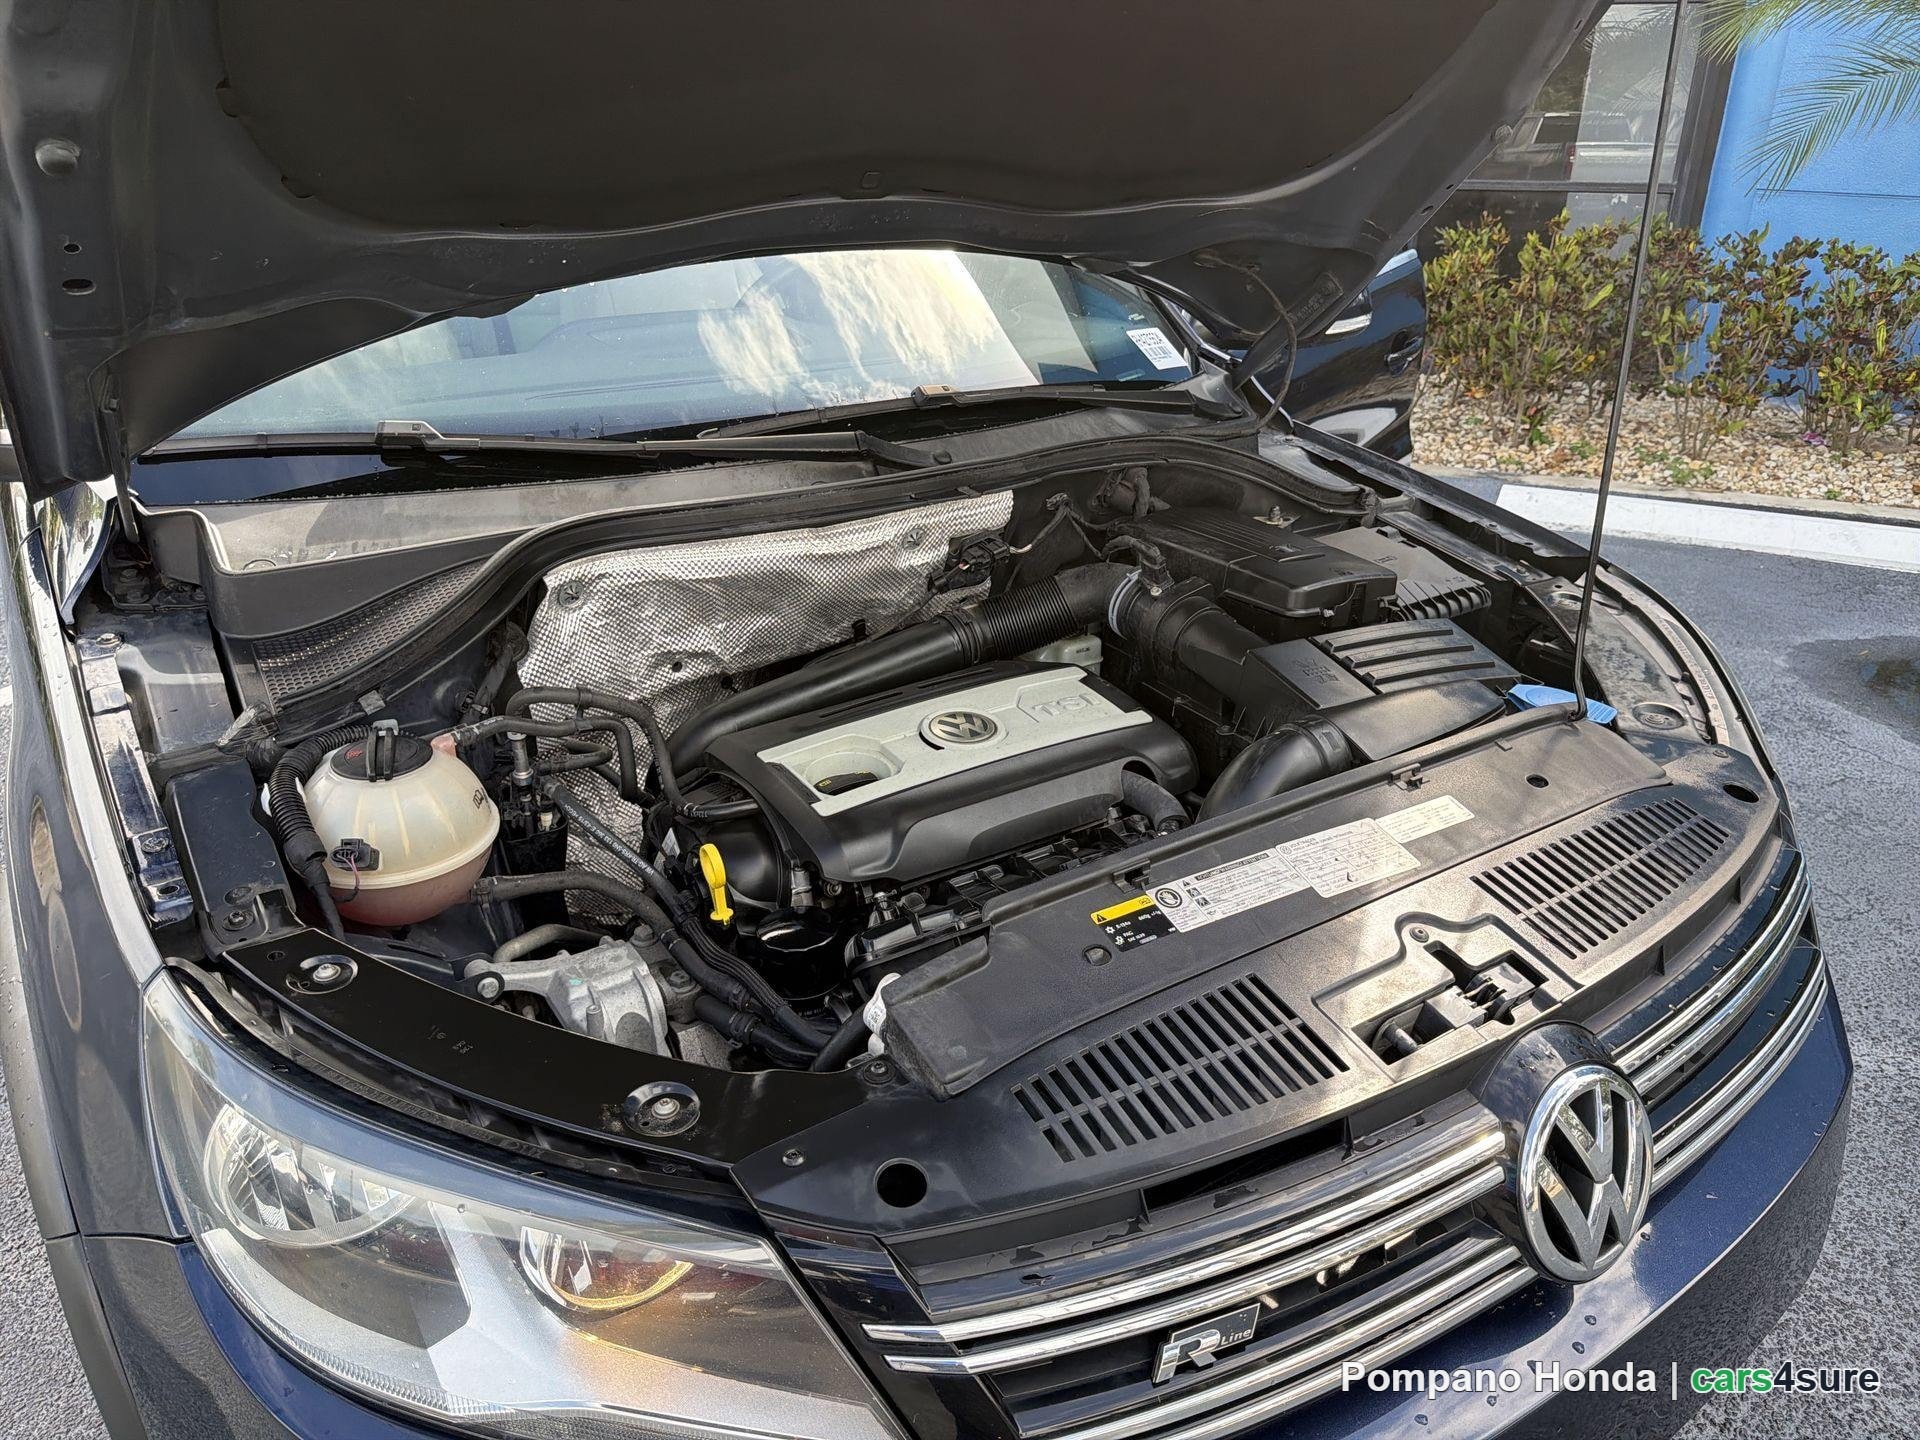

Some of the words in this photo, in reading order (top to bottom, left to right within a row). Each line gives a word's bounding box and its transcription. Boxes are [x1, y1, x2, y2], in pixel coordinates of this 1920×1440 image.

[1032, 693, 1101, 717] TSI
[1153, 1329, 1221, 1384] R
[1220, 1328, 1252, 1346] Line
